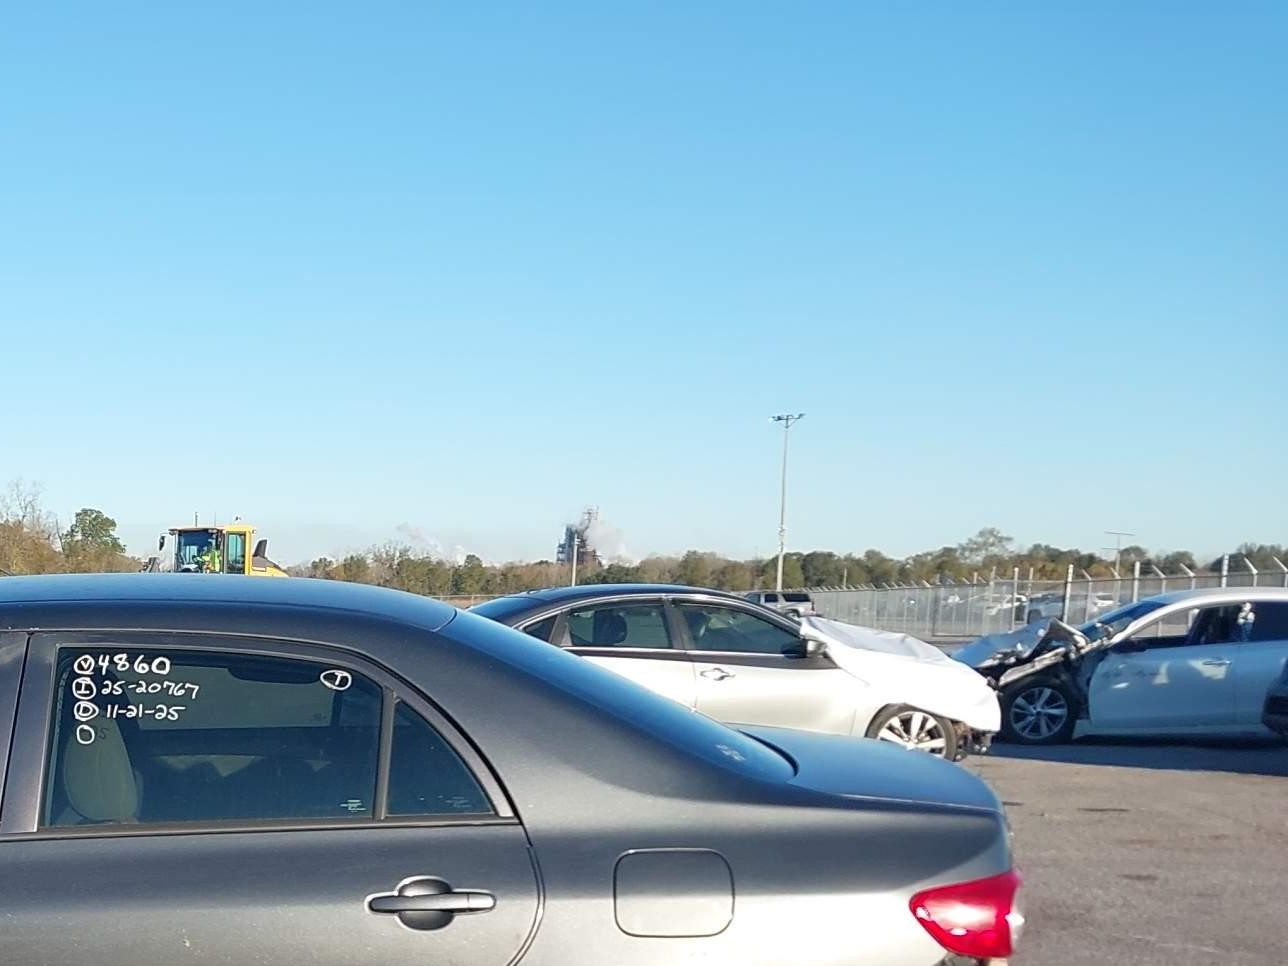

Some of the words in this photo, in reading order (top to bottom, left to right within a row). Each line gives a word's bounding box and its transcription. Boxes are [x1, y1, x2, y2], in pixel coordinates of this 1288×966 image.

[98, 653, 171, 676] 4860
[101, 680, 200, 700] 25-20767
[106, 703, 187, 720] 11-21-25
